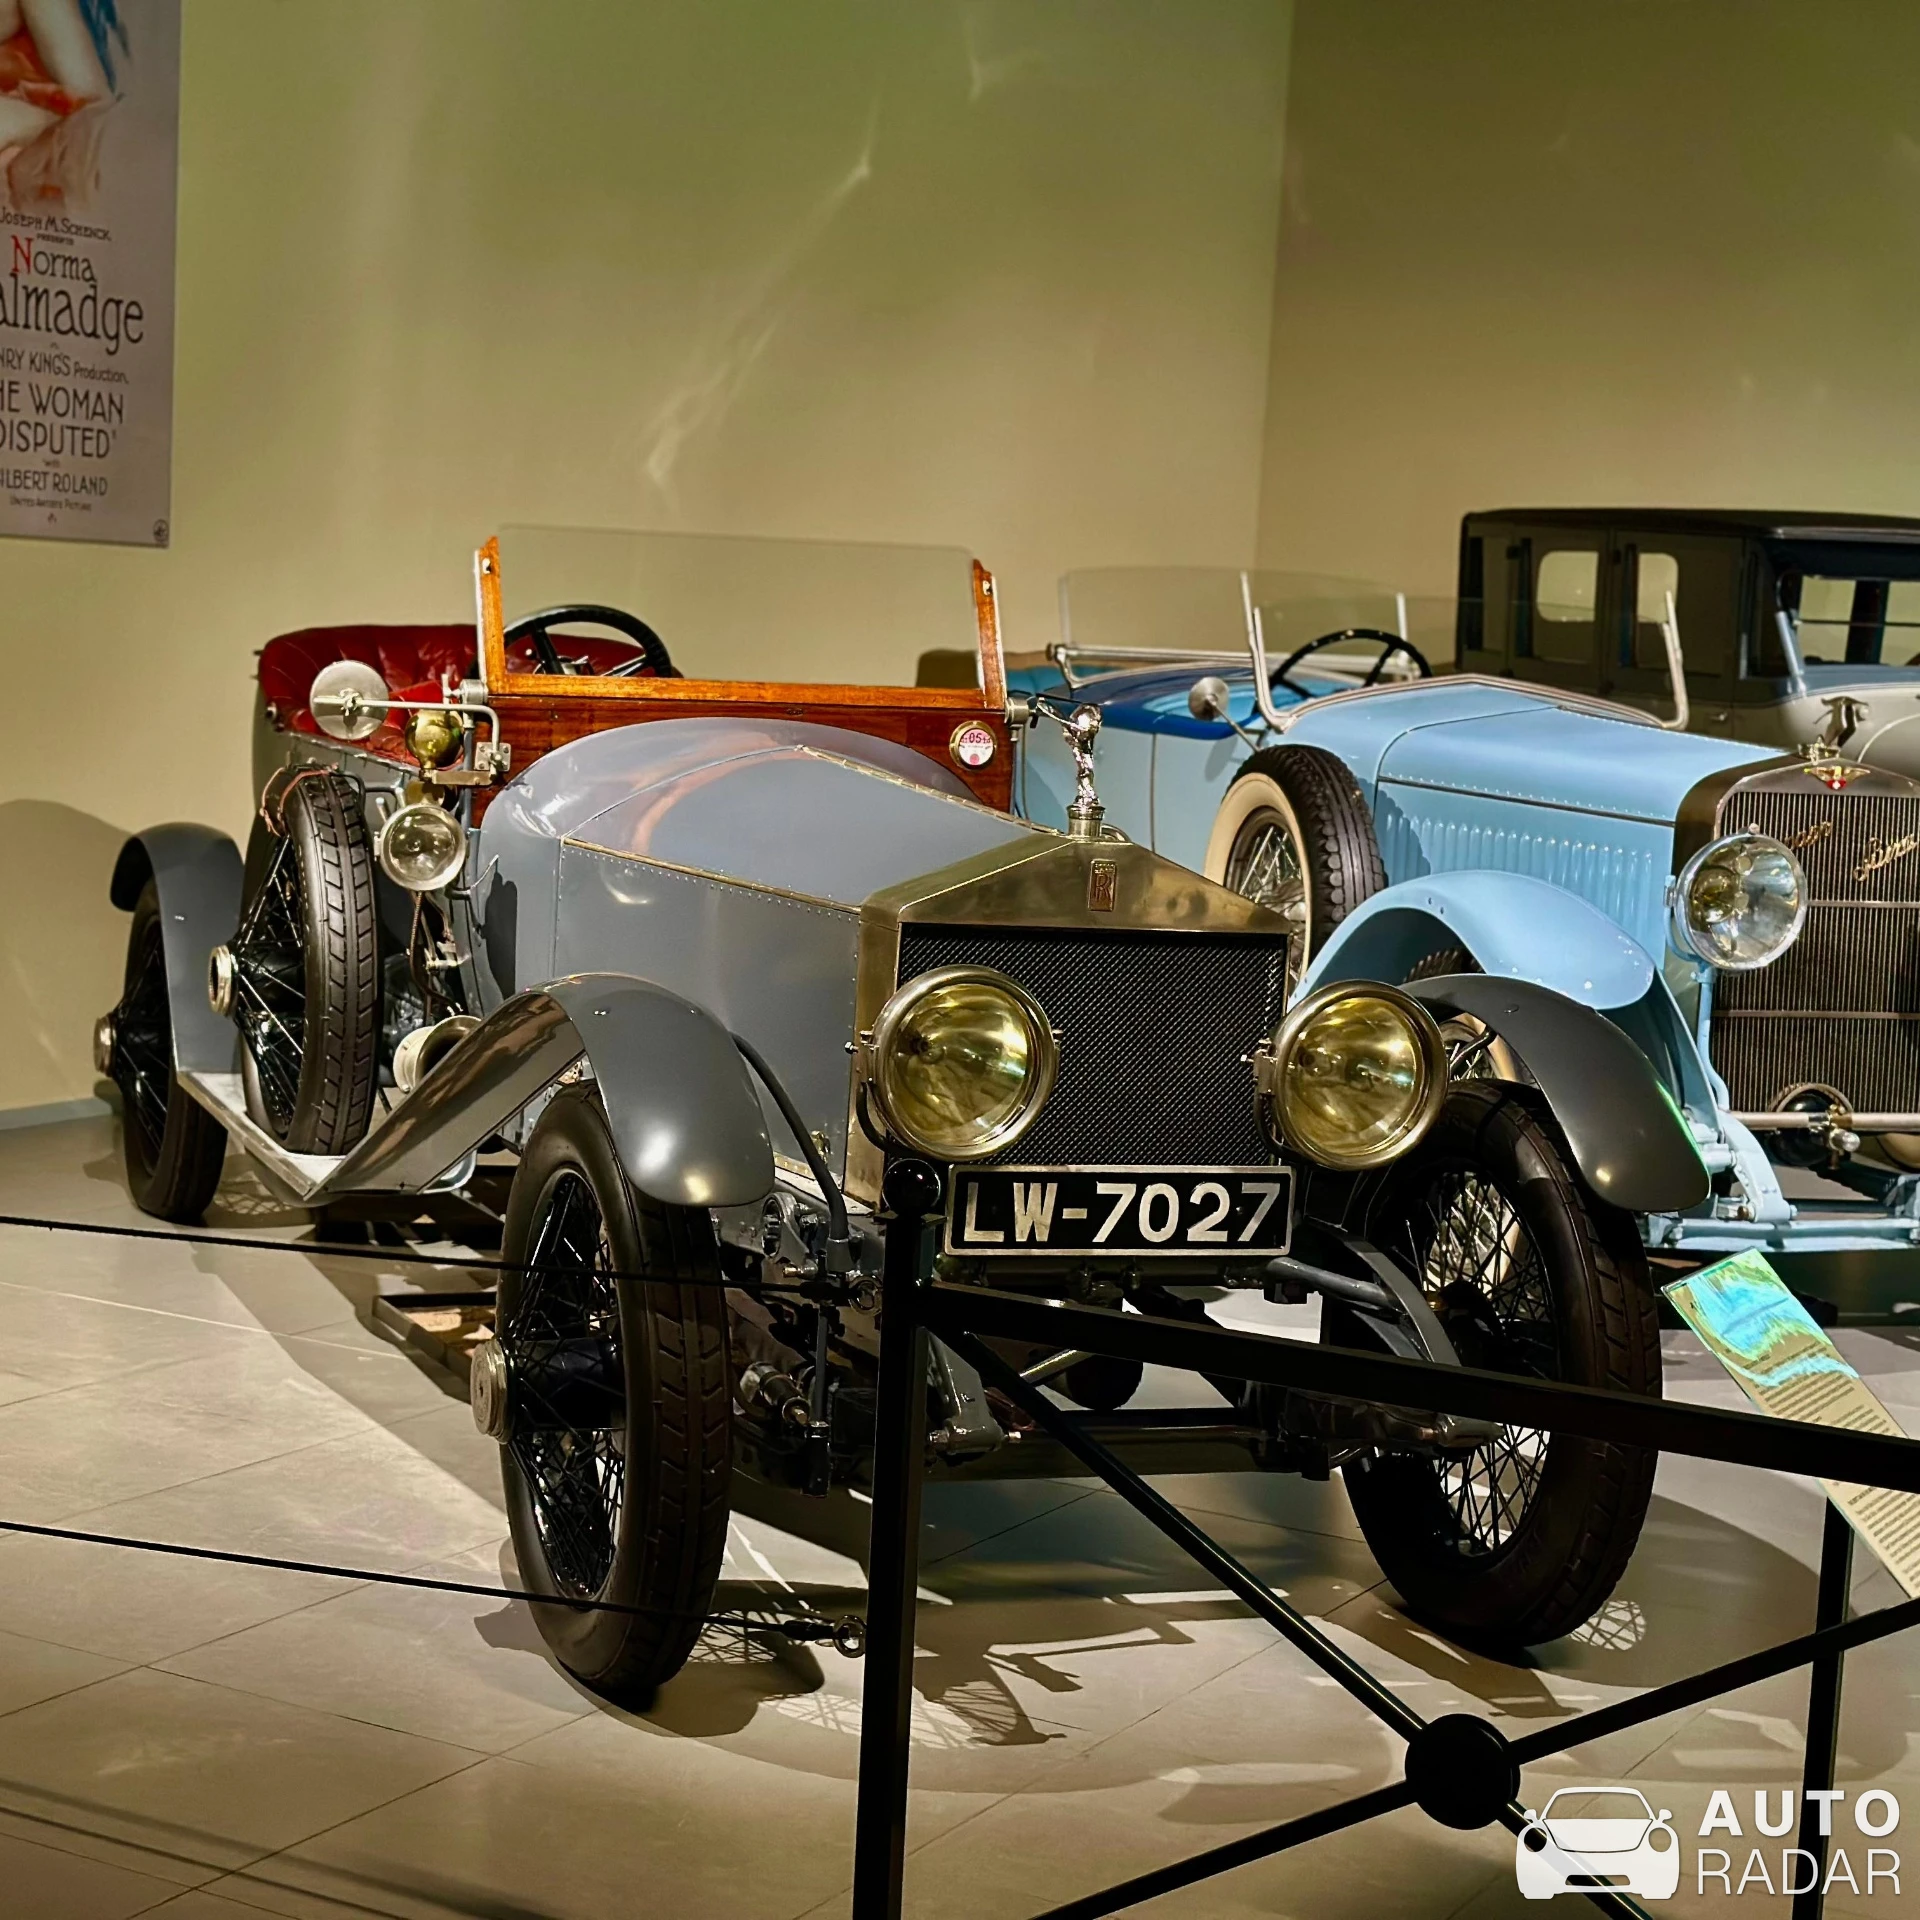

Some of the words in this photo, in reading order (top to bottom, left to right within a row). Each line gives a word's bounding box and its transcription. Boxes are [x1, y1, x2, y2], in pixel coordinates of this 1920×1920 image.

[11, 235, 97, 283] Norma
[29, 382, 124, 424] WOMAN
[53, 472, 108, 496] ROLAND
